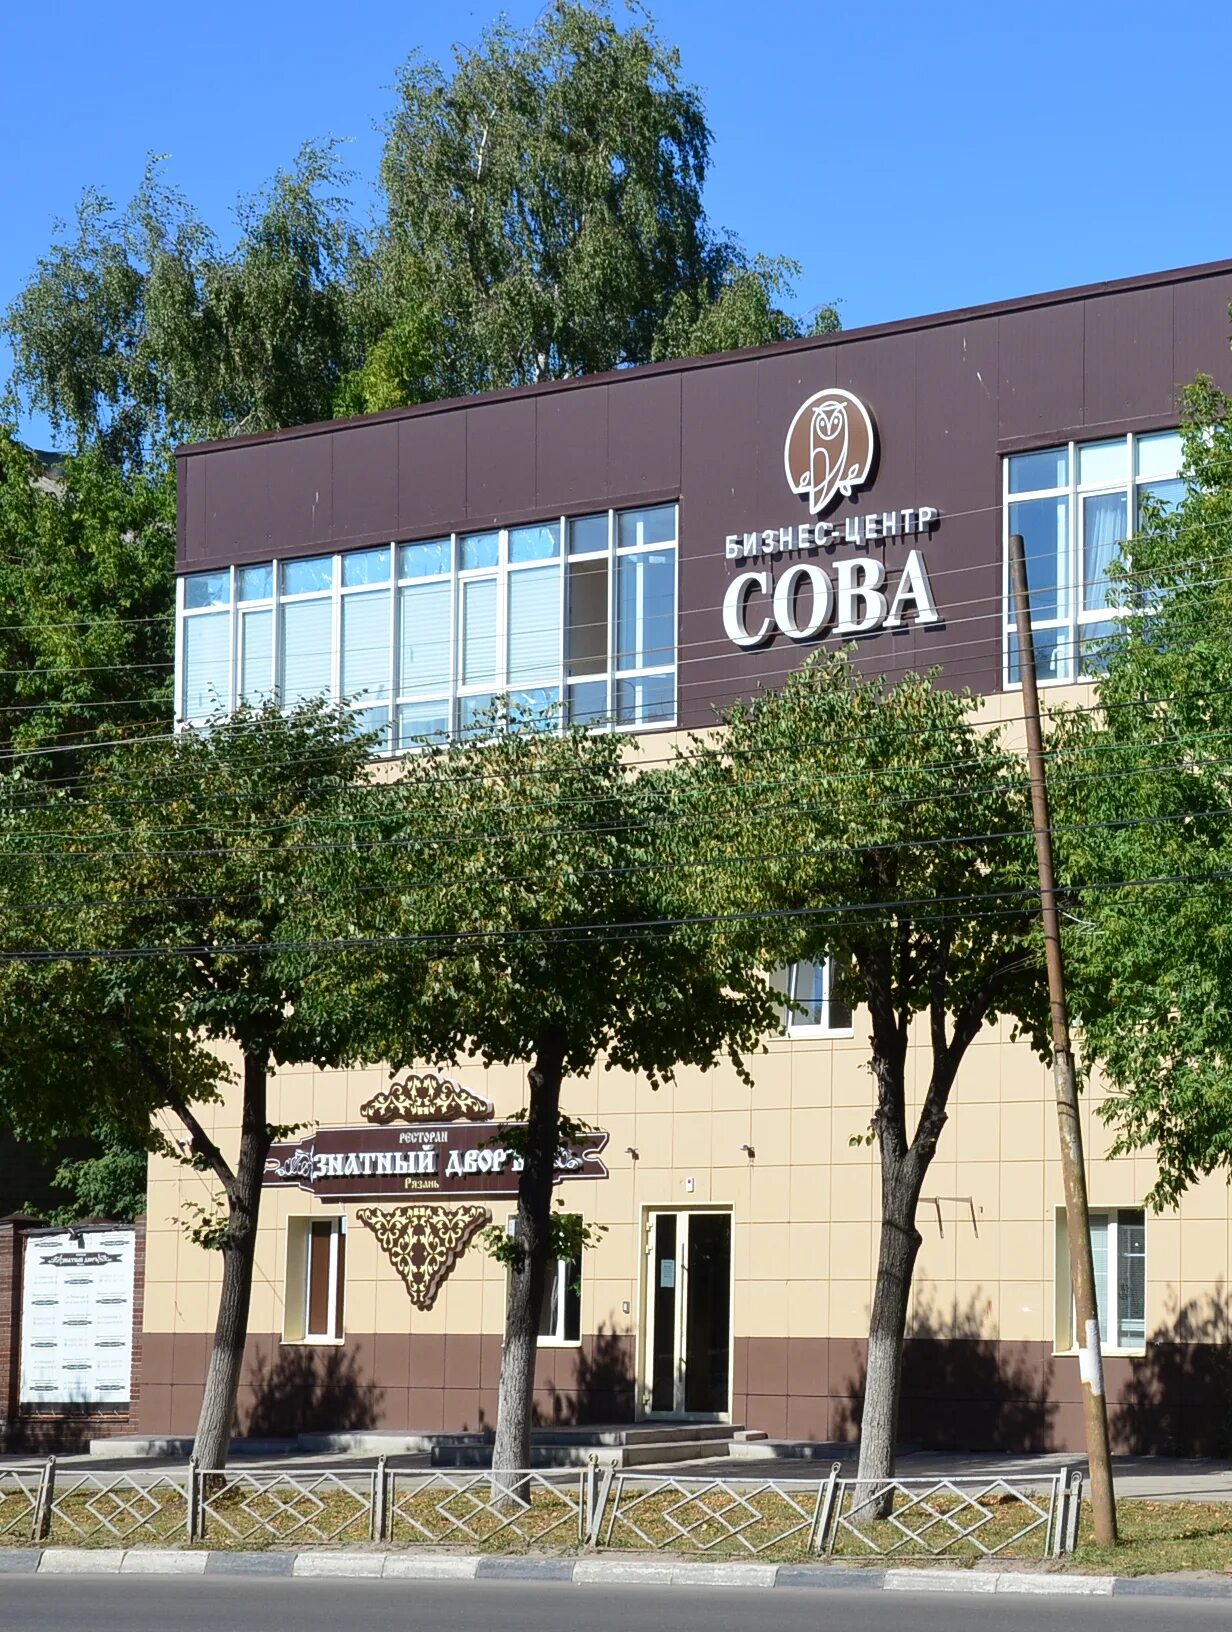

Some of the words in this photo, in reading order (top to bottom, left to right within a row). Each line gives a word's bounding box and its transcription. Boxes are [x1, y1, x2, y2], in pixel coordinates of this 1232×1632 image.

[725, 506, 938, 559] БИЗНЕС-ЦЕНТР
[722, 549, 942, 646] СОВА
[399, 1131, 448, 1144] РЕСТОРАН
[312, 1144, 436, 1179] ЗНАТНЫЙ
[404, 1177, 440, 1189] Рязань
